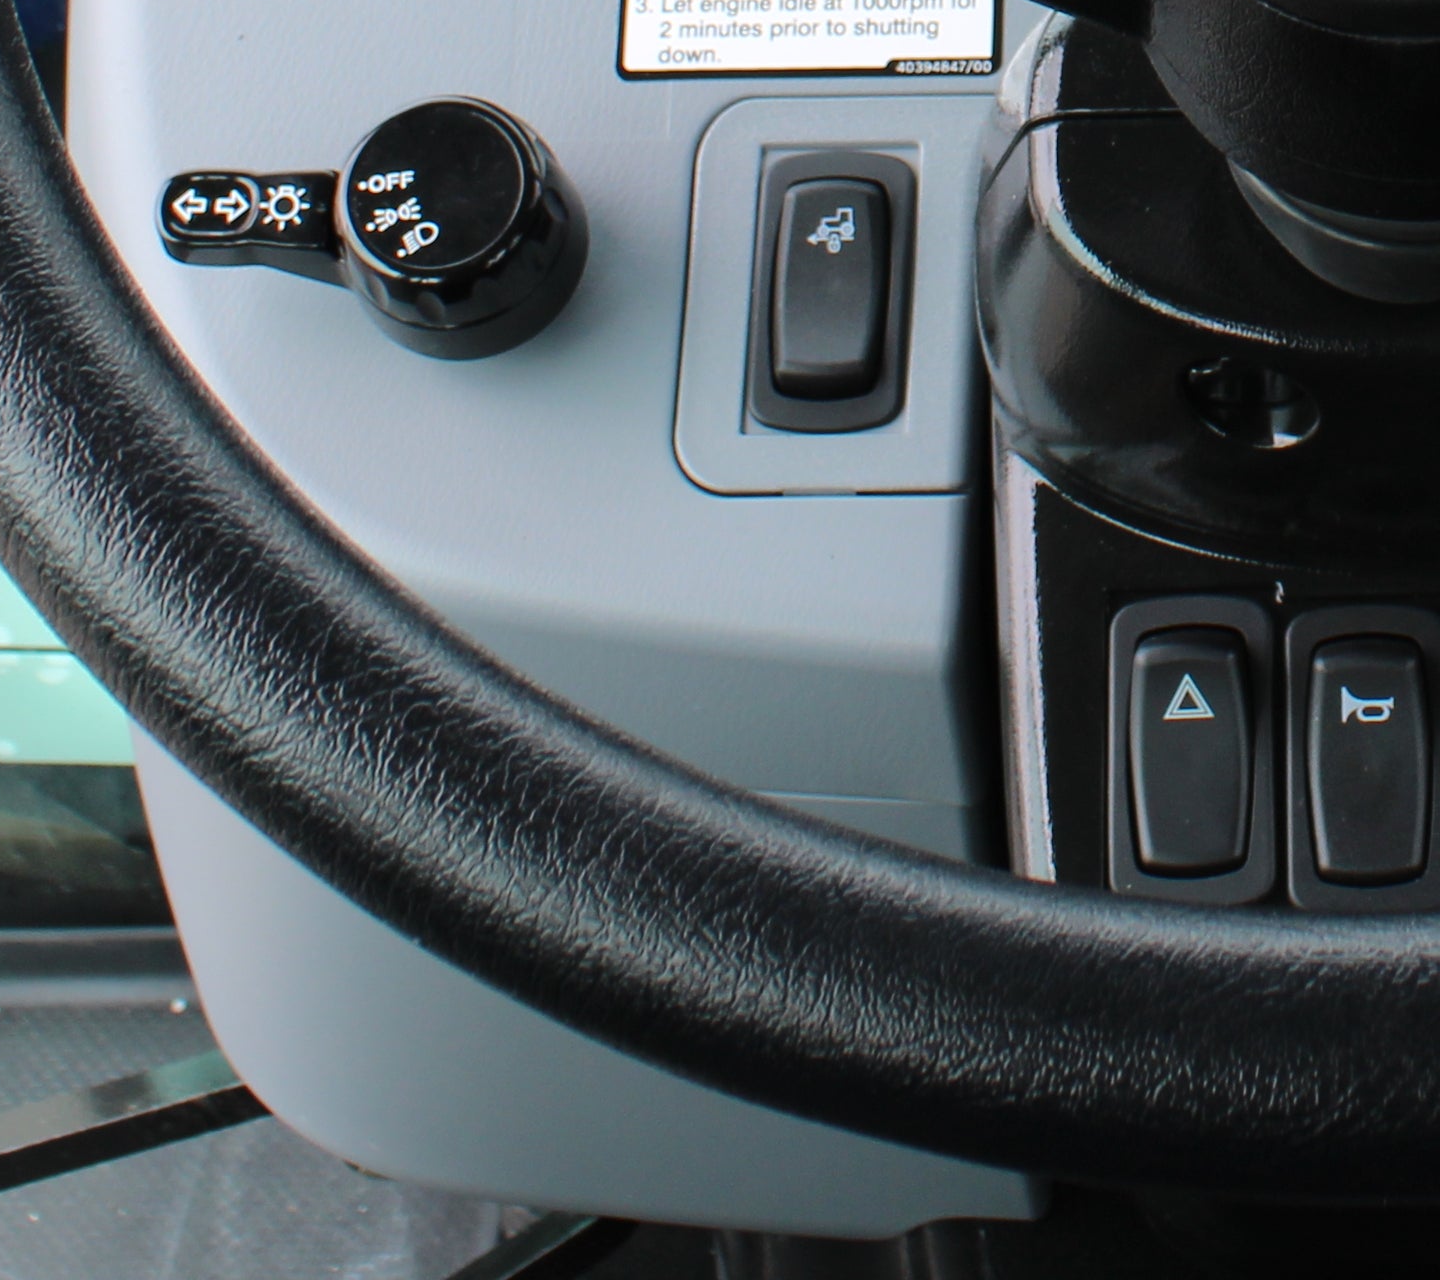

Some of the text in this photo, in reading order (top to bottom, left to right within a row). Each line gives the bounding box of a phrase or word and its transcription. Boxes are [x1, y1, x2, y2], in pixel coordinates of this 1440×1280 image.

[659, 17, 940, 42] 2 minutes prior to shutting
[657, 45, 723, 65] down.
[367, 170, 415, 194] OFF
